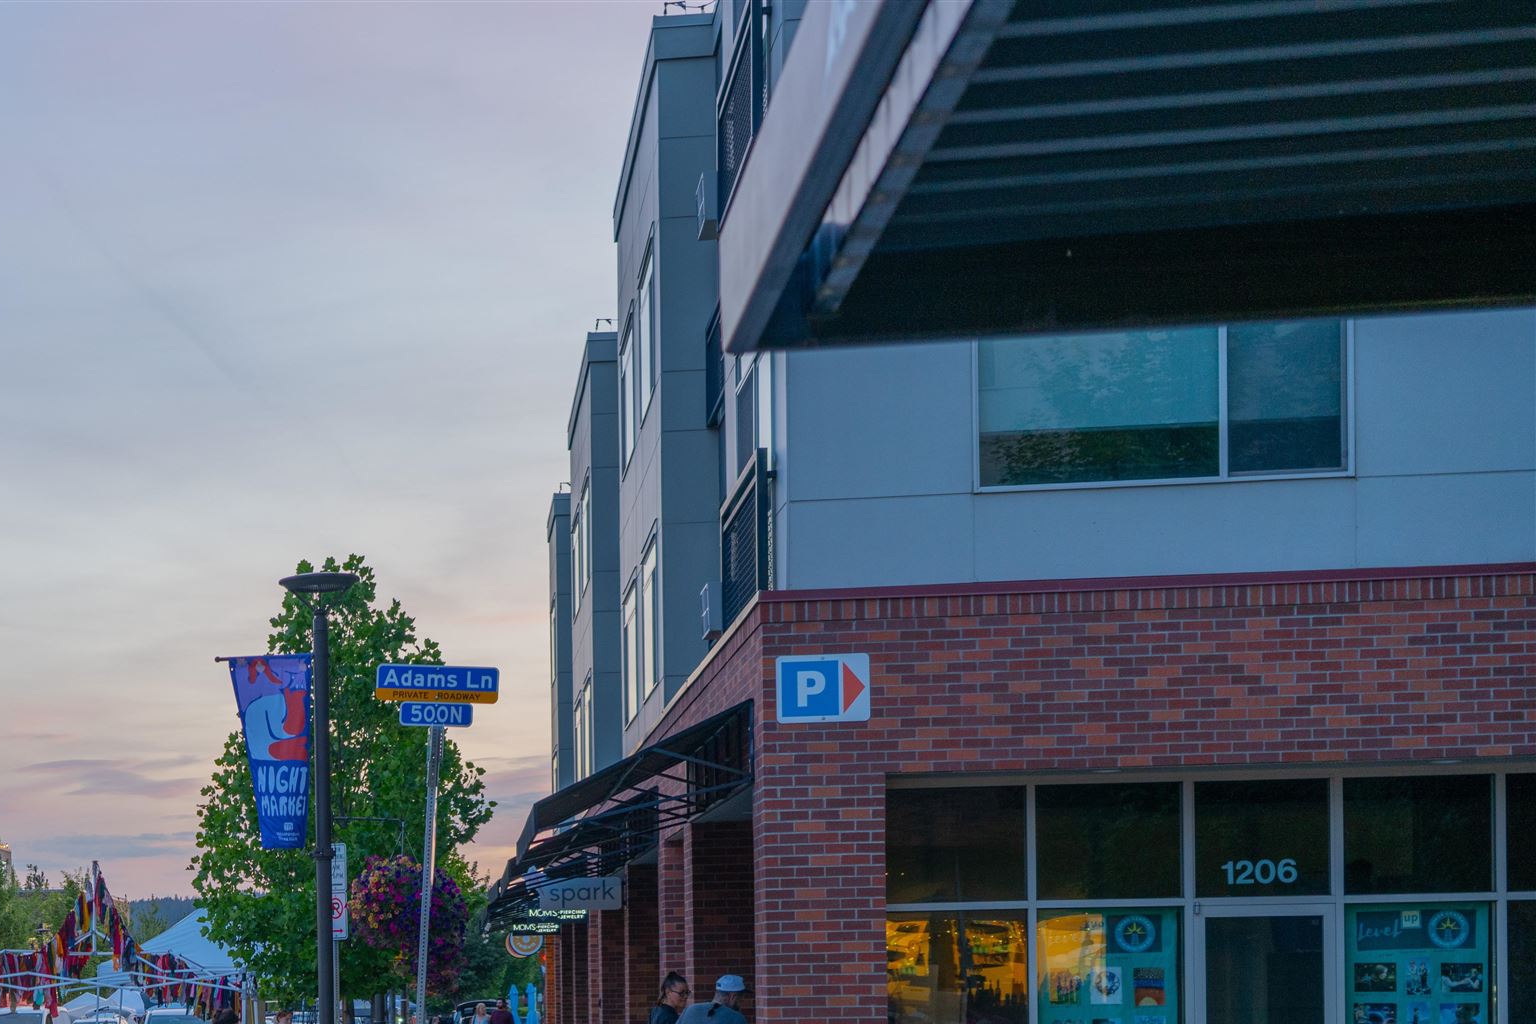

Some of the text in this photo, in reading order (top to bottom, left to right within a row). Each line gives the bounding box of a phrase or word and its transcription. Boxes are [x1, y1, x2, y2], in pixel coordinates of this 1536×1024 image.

[383, 668, 493, 689] Adams Ln
[796, 670, 826, 708] P
[392, 690, 481, 701] PRIVATE ROADWAY
[410, 704, 463, 724] 500N
[257, 765, 308, 794] NIGHT
[1220, 858, 1298, 885] 1206
[550, 879, 615, 909] spark
[1404, 914, 1419, 926] up
